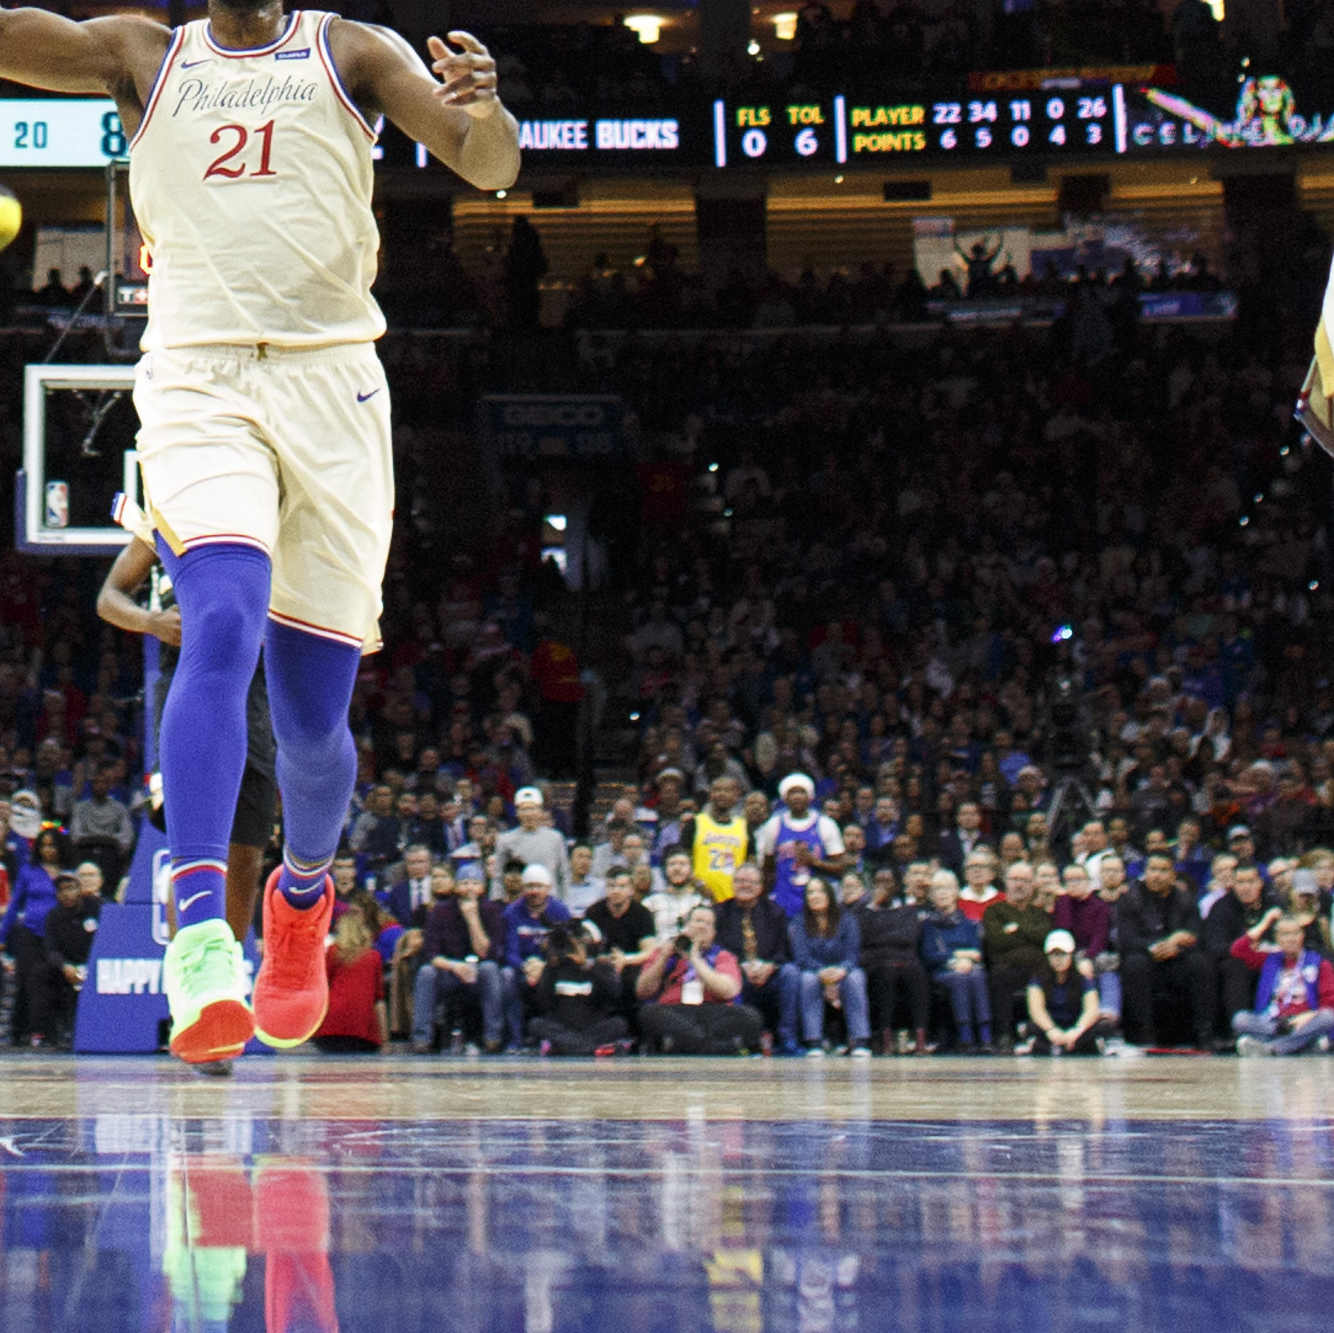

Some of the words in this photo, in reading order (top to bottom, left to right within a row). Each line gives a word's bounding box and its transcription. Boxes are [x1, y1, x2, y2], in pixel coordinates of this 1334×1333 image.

[172, 75, 317, 117] Philadelphia
[851, 105, 925, 127] PLAYER
[933, 102, 962, 124] 22
[968, 100, 997, 123] 34
[1009, 99, 1031, 121] 11
[1046, 97, 1065, 120] 0
[1077, 96, 1107, 118] 26
[737, 106, 771, 128] FLS
[786, 105, 824, 125] TOL
[14, 121, 47, 149] 20
[203, 119, 276, 180] 21
[595, 119, 679, 150] BUCKS
[741, 128, 767, 158] 0
[794, 127, 818, 156] 6
[853, 131, 926, 153] POINTS
[940, 128, 957, 150] 6
[974, 127, 992, 149] 5
[1011, 125, 1030, 147] 0
[1048, 124, 1066, 146] 4
[1086, 123, 1102, 145] 3
[503, 405, 604, 427] GEICO
